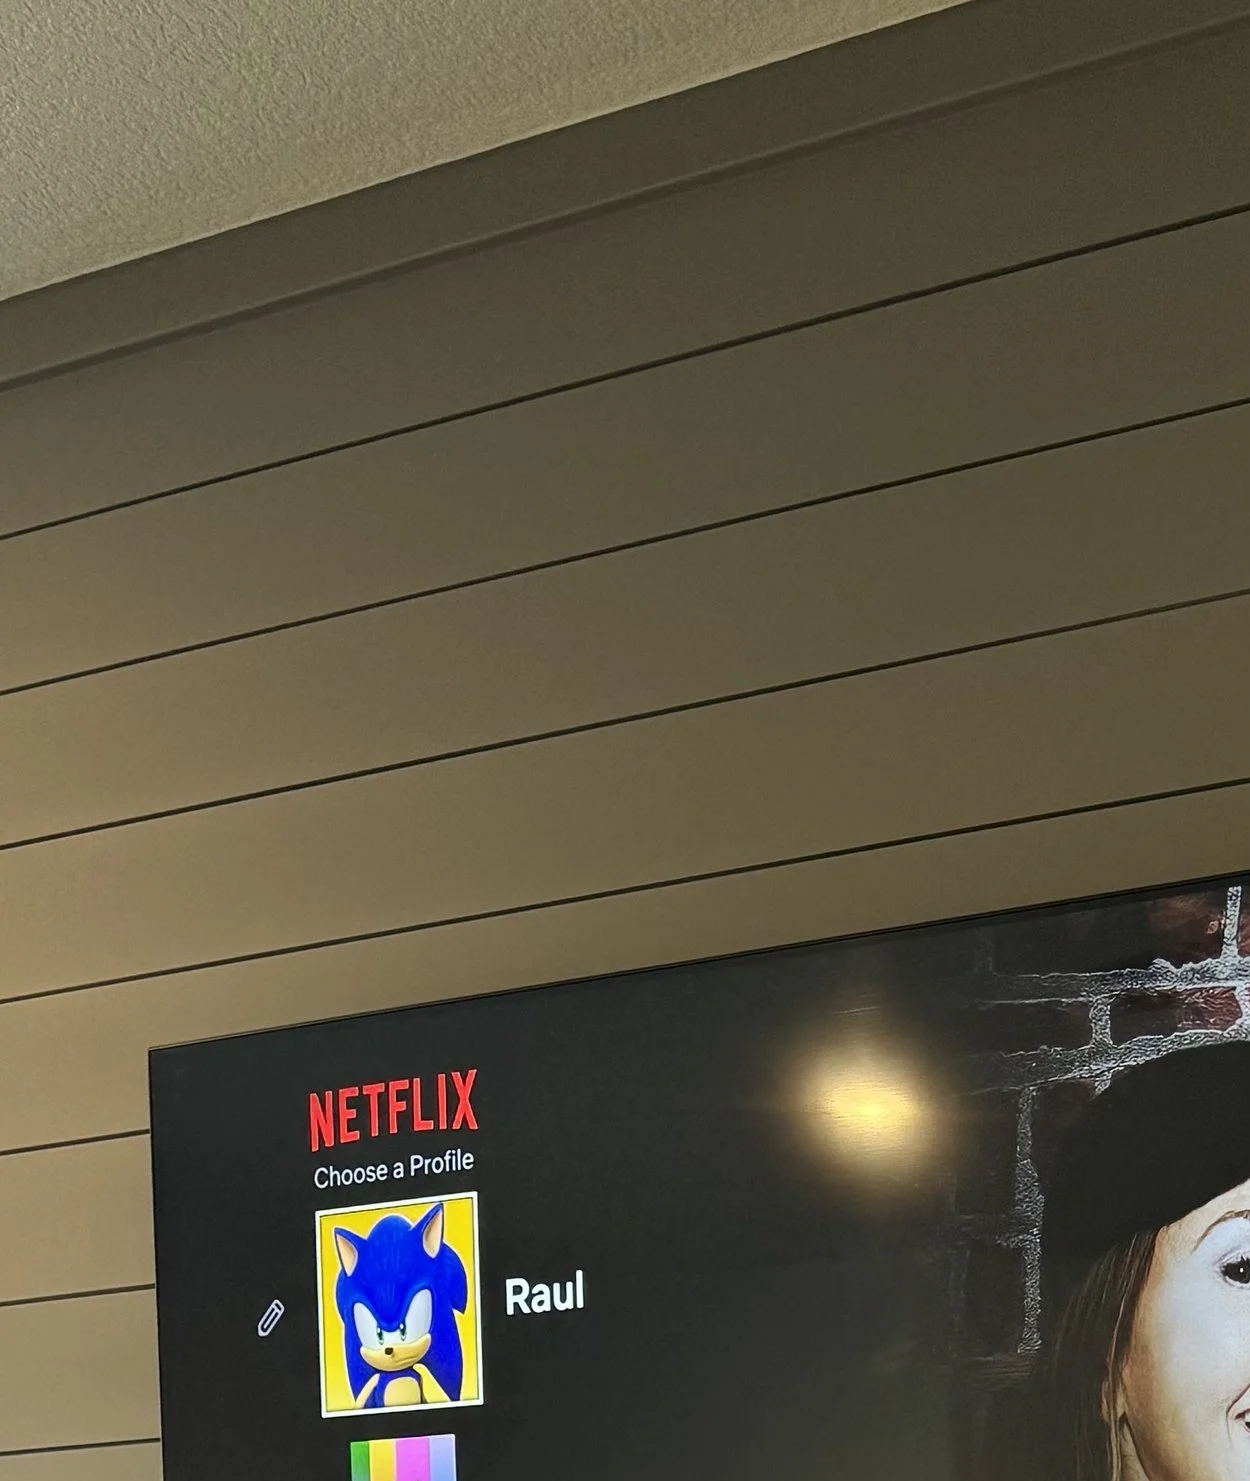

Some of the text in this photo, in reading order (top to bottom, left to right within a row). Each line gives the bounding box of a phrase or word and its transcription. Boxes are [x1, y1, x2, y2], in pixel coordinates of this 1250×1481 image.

[309, 1069, 479, 1152] NETFLIX
[314, 1148, 475, 1189] Choose a Profile
[505, 1270, 584, 1316] Raul
